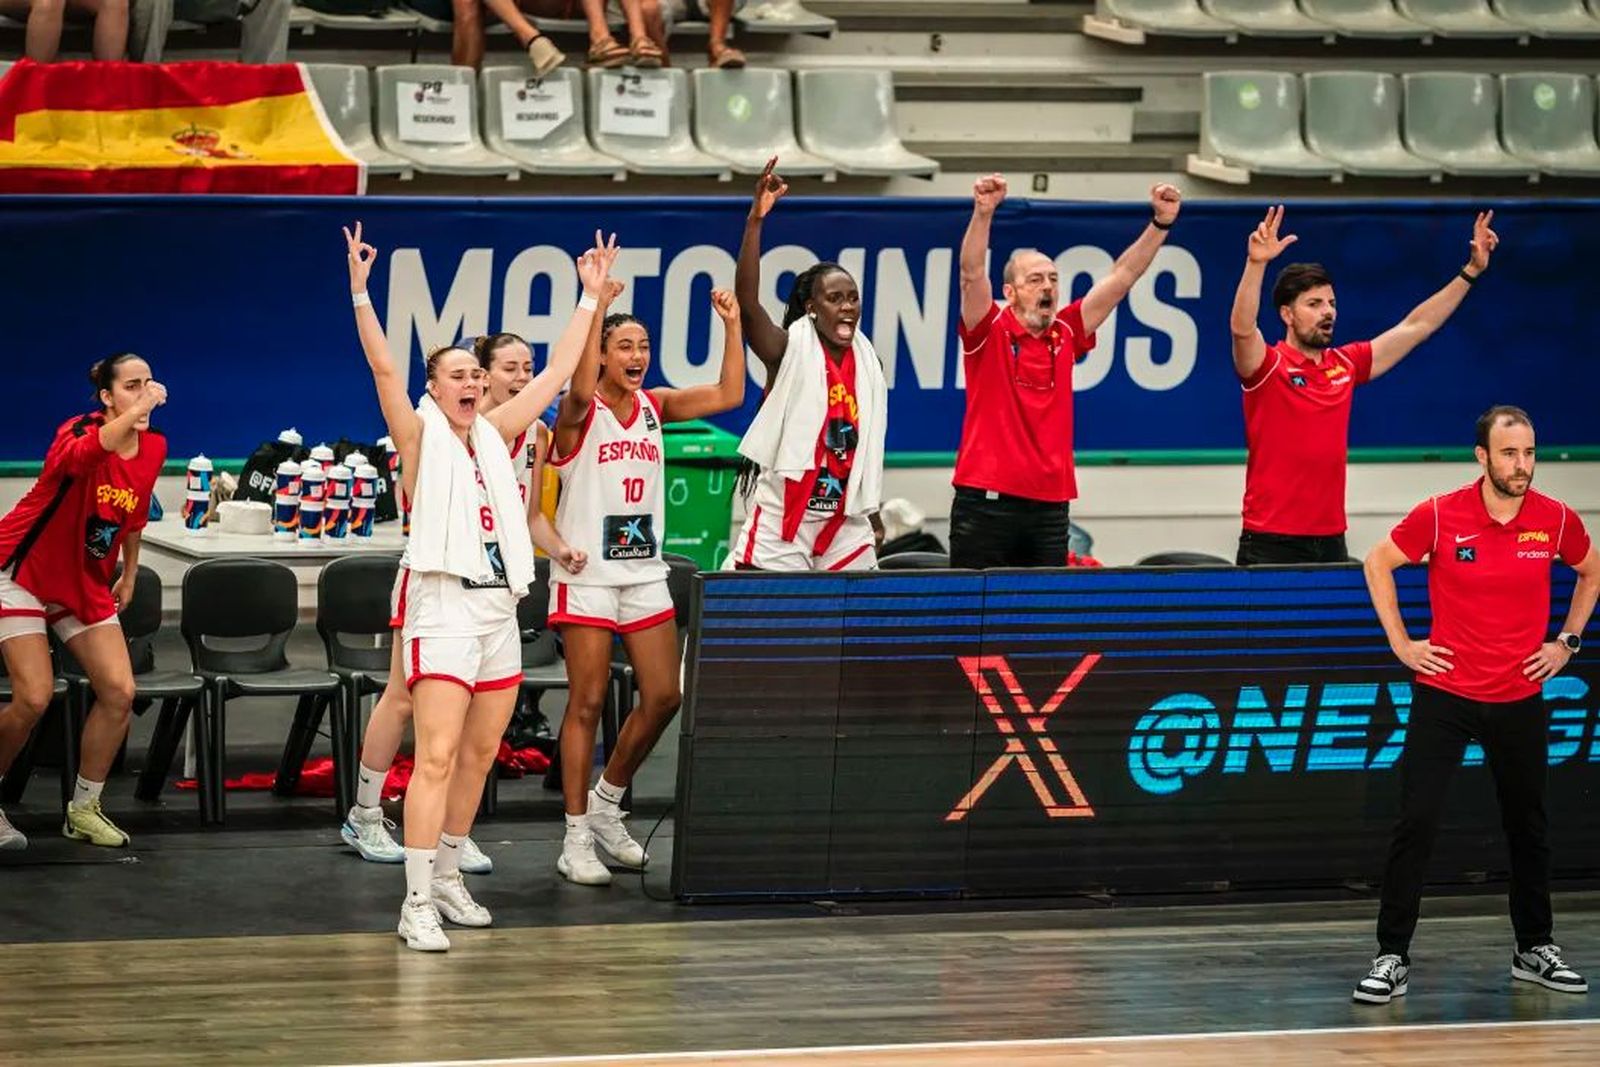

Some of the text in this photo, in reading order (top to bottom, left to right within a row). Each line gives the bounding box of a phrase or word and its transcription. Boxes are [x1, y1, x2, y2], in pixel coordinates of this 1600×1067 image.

[598, 437, 660, 464] ESPAÑA
[622, 477, 644, 503] 10
[479, 505, 494, 532] 6
